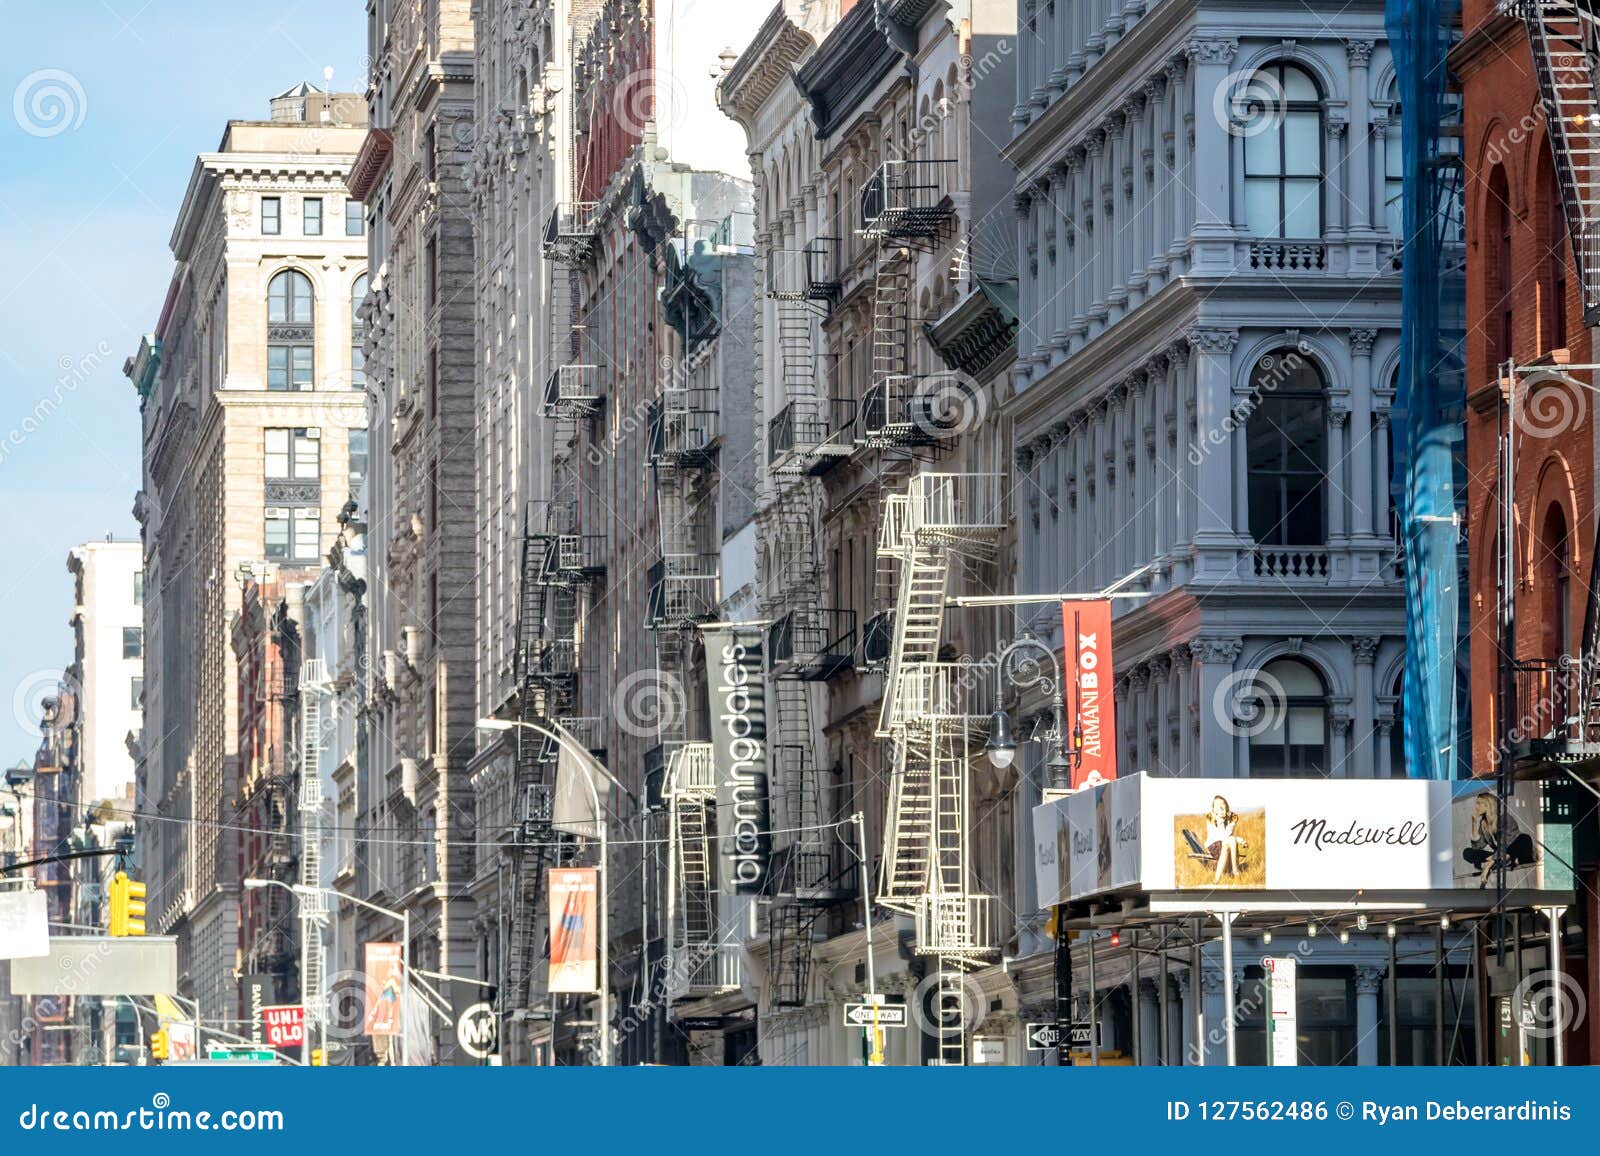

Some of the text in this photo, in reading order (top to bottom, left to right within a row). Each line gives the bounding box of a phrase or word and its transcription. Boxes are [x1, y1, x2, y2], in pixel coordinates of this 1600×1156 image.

[1290, 818, 1428, 852] Madewell
[252, 984, 262, 1030] BANANA
[854, 1011, 898, 1020] ONE WAY
[268, 1010, 298, 1025] UNI
[270, 1026, 302, 1044] QLO
